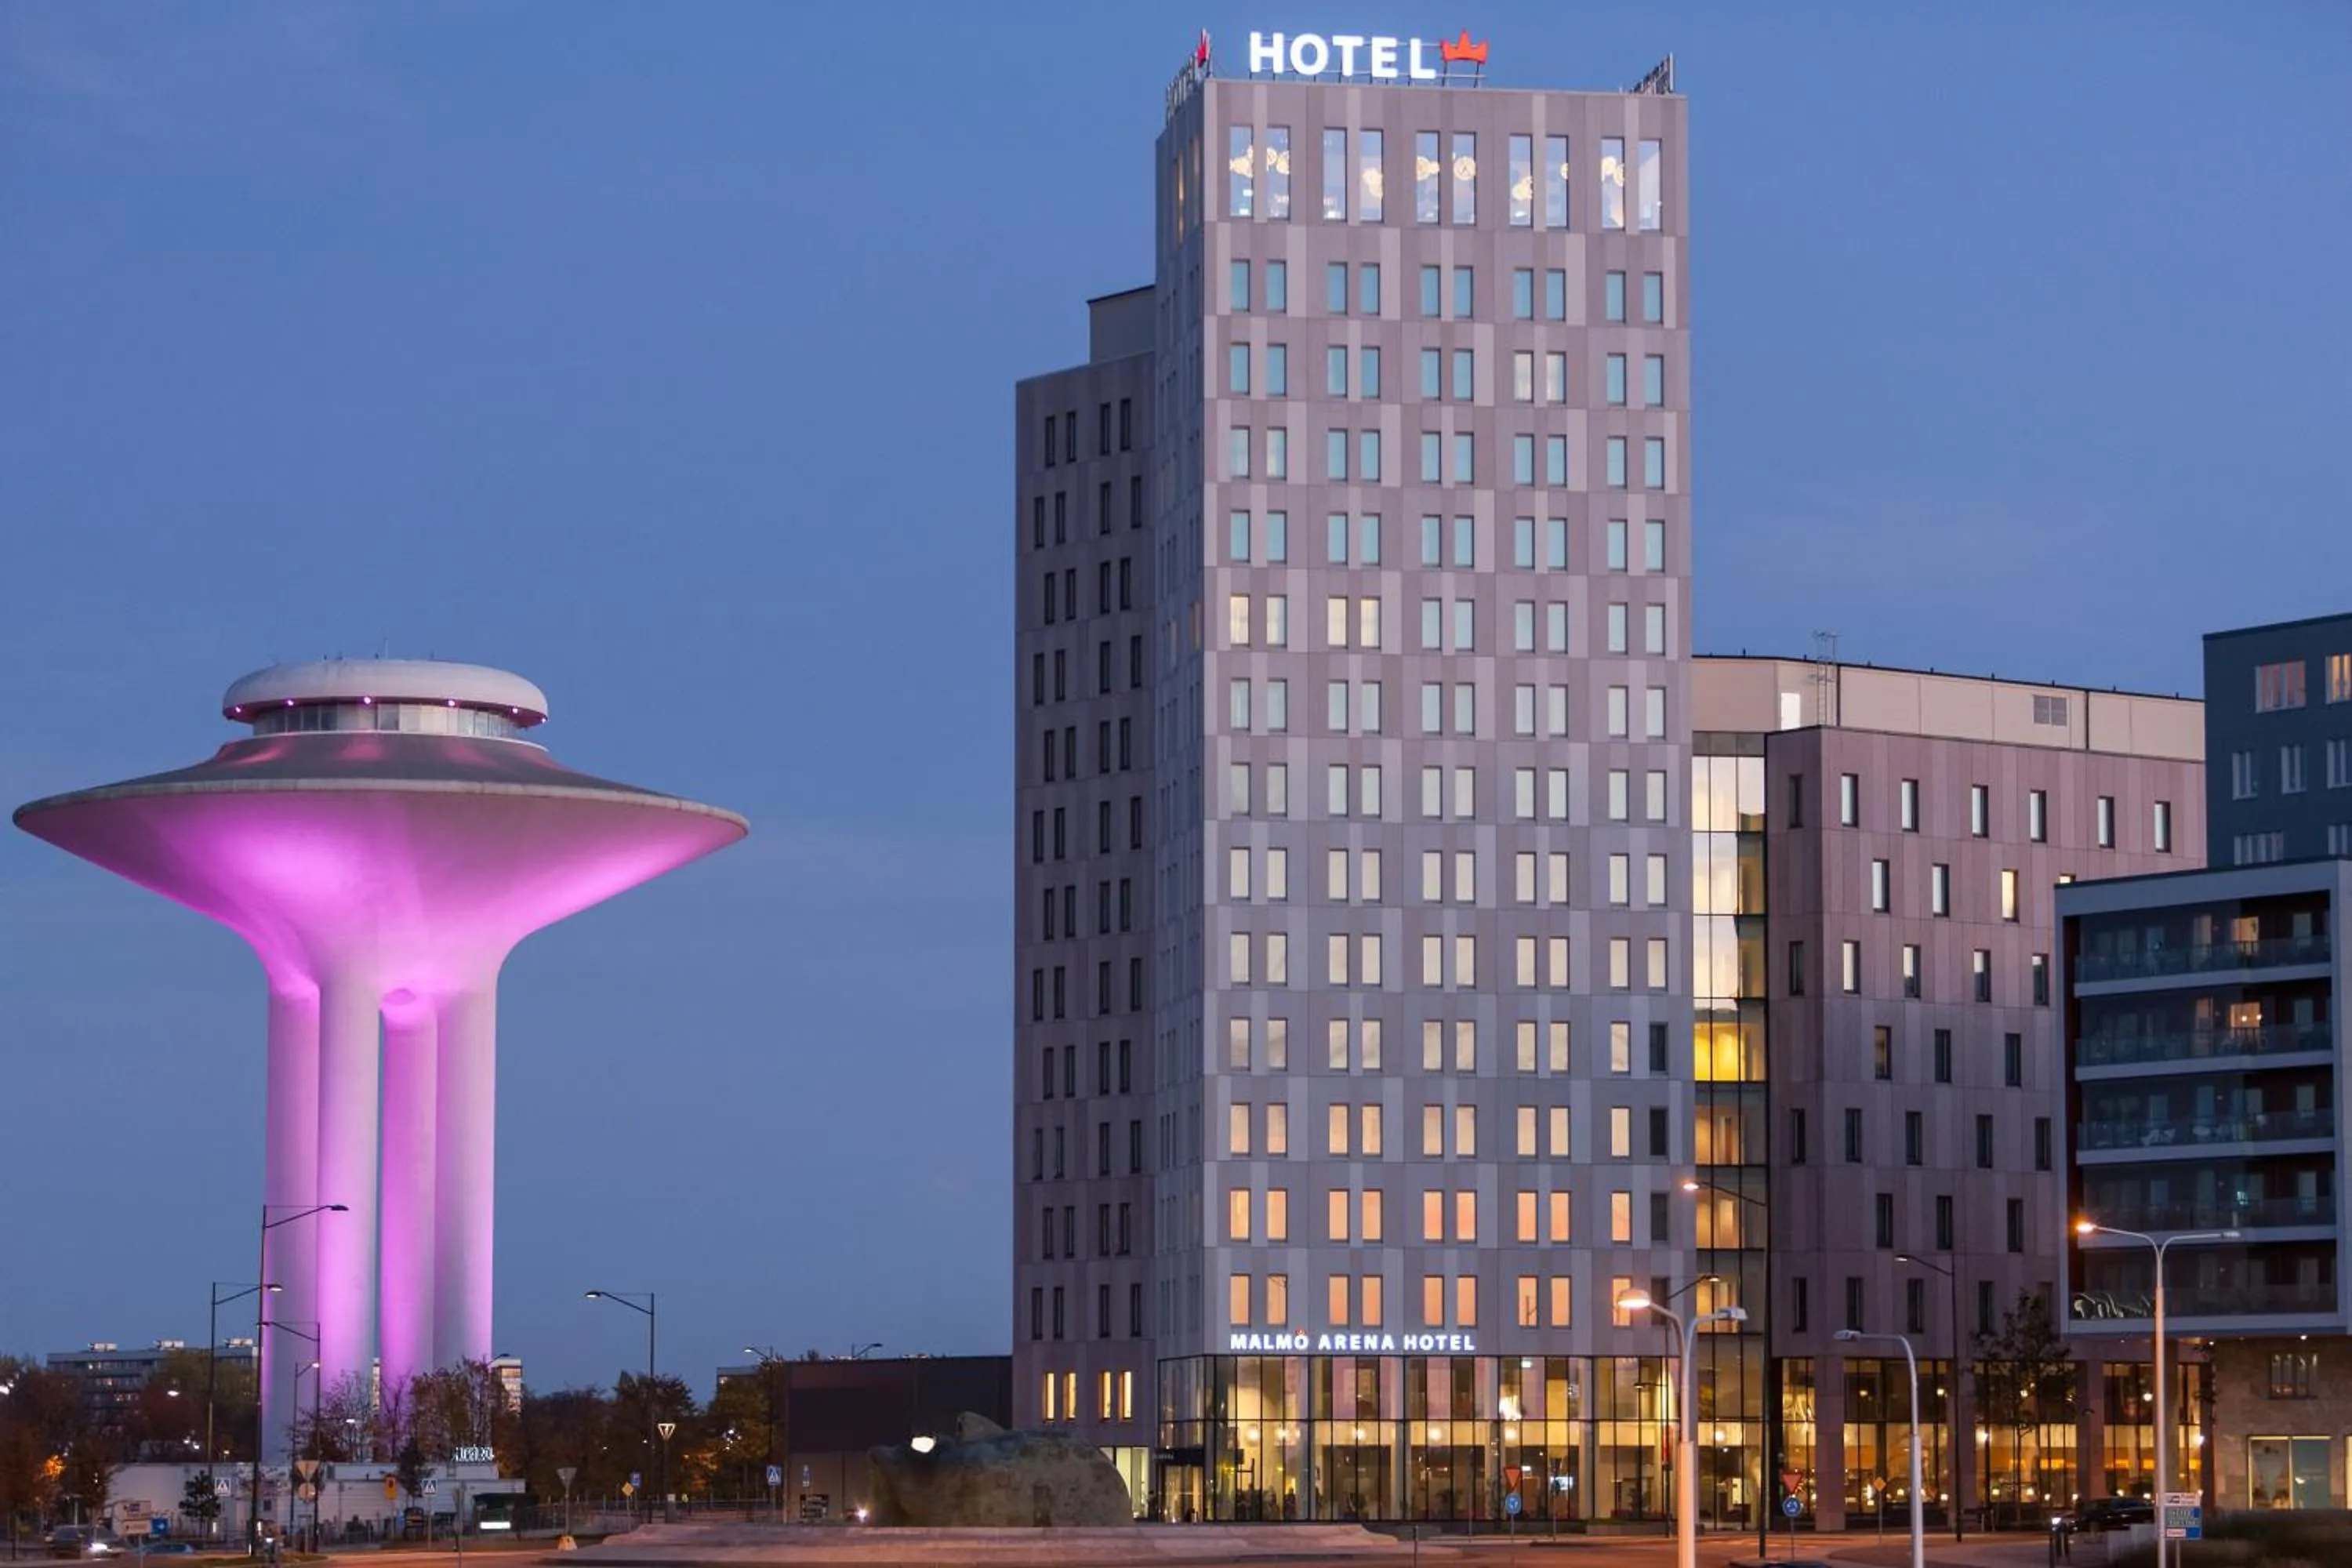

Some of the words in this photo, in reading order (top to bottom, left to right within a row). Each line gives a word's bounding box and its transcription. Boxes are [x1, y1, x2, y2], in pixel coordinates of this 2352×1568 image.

[1249, 31, 1436, 79] HOTEL
[1318, 1334, 1396, 1351] ARENA
[1403, 1334, 1476, 1352] HOTEL
